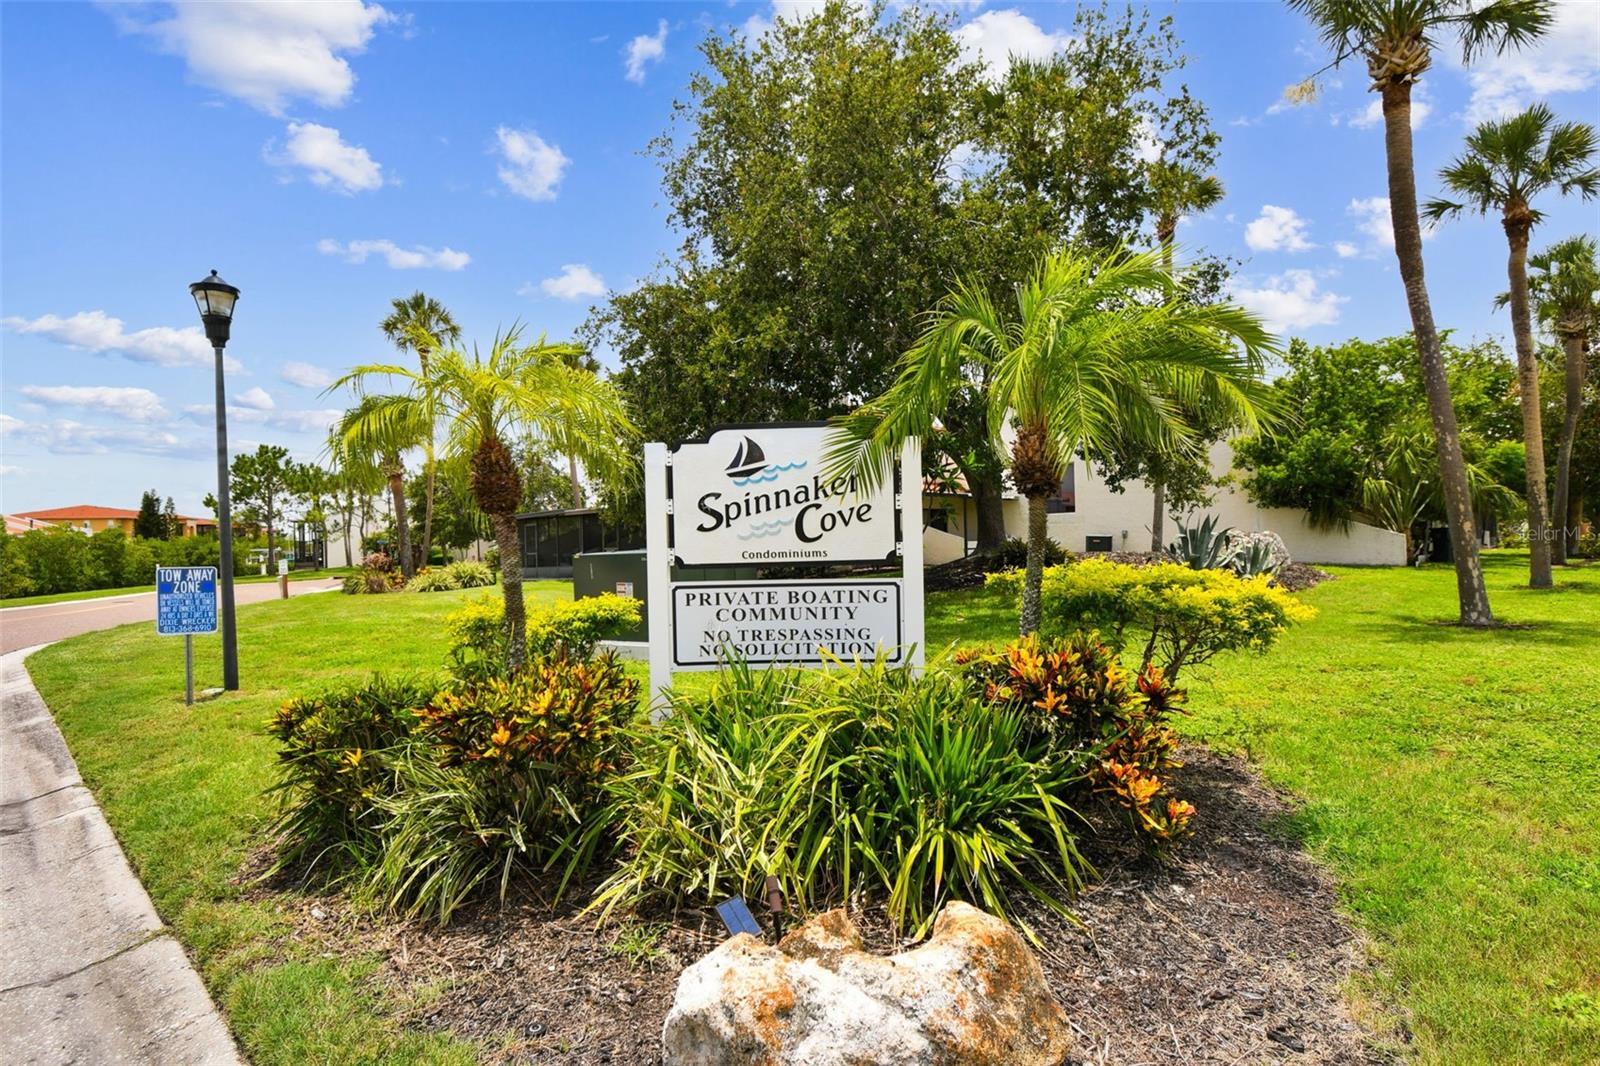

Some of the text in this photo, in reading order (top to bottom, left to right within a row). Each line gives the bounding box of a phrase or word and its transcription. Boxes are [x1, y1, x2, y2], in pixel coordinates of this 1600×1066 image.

[697, 473, 859, 532] Spinnaker
[795, 503, 872, 543] Cove
[741, 549, 828, 560] Condominiums
[160, 568, 214, 582] TOW AWAY
[173, 581, 201, 594] ZONE
[685, 589, 888, 607] PRIVATE BOATING
[160, 617, 216, 626] DIXIE WRECKER
[715, 606, 858, 623] COMMUNITY
[703, 627, 871, 643] NO TRESPASSING
[699, 643, 726, 657] NO
